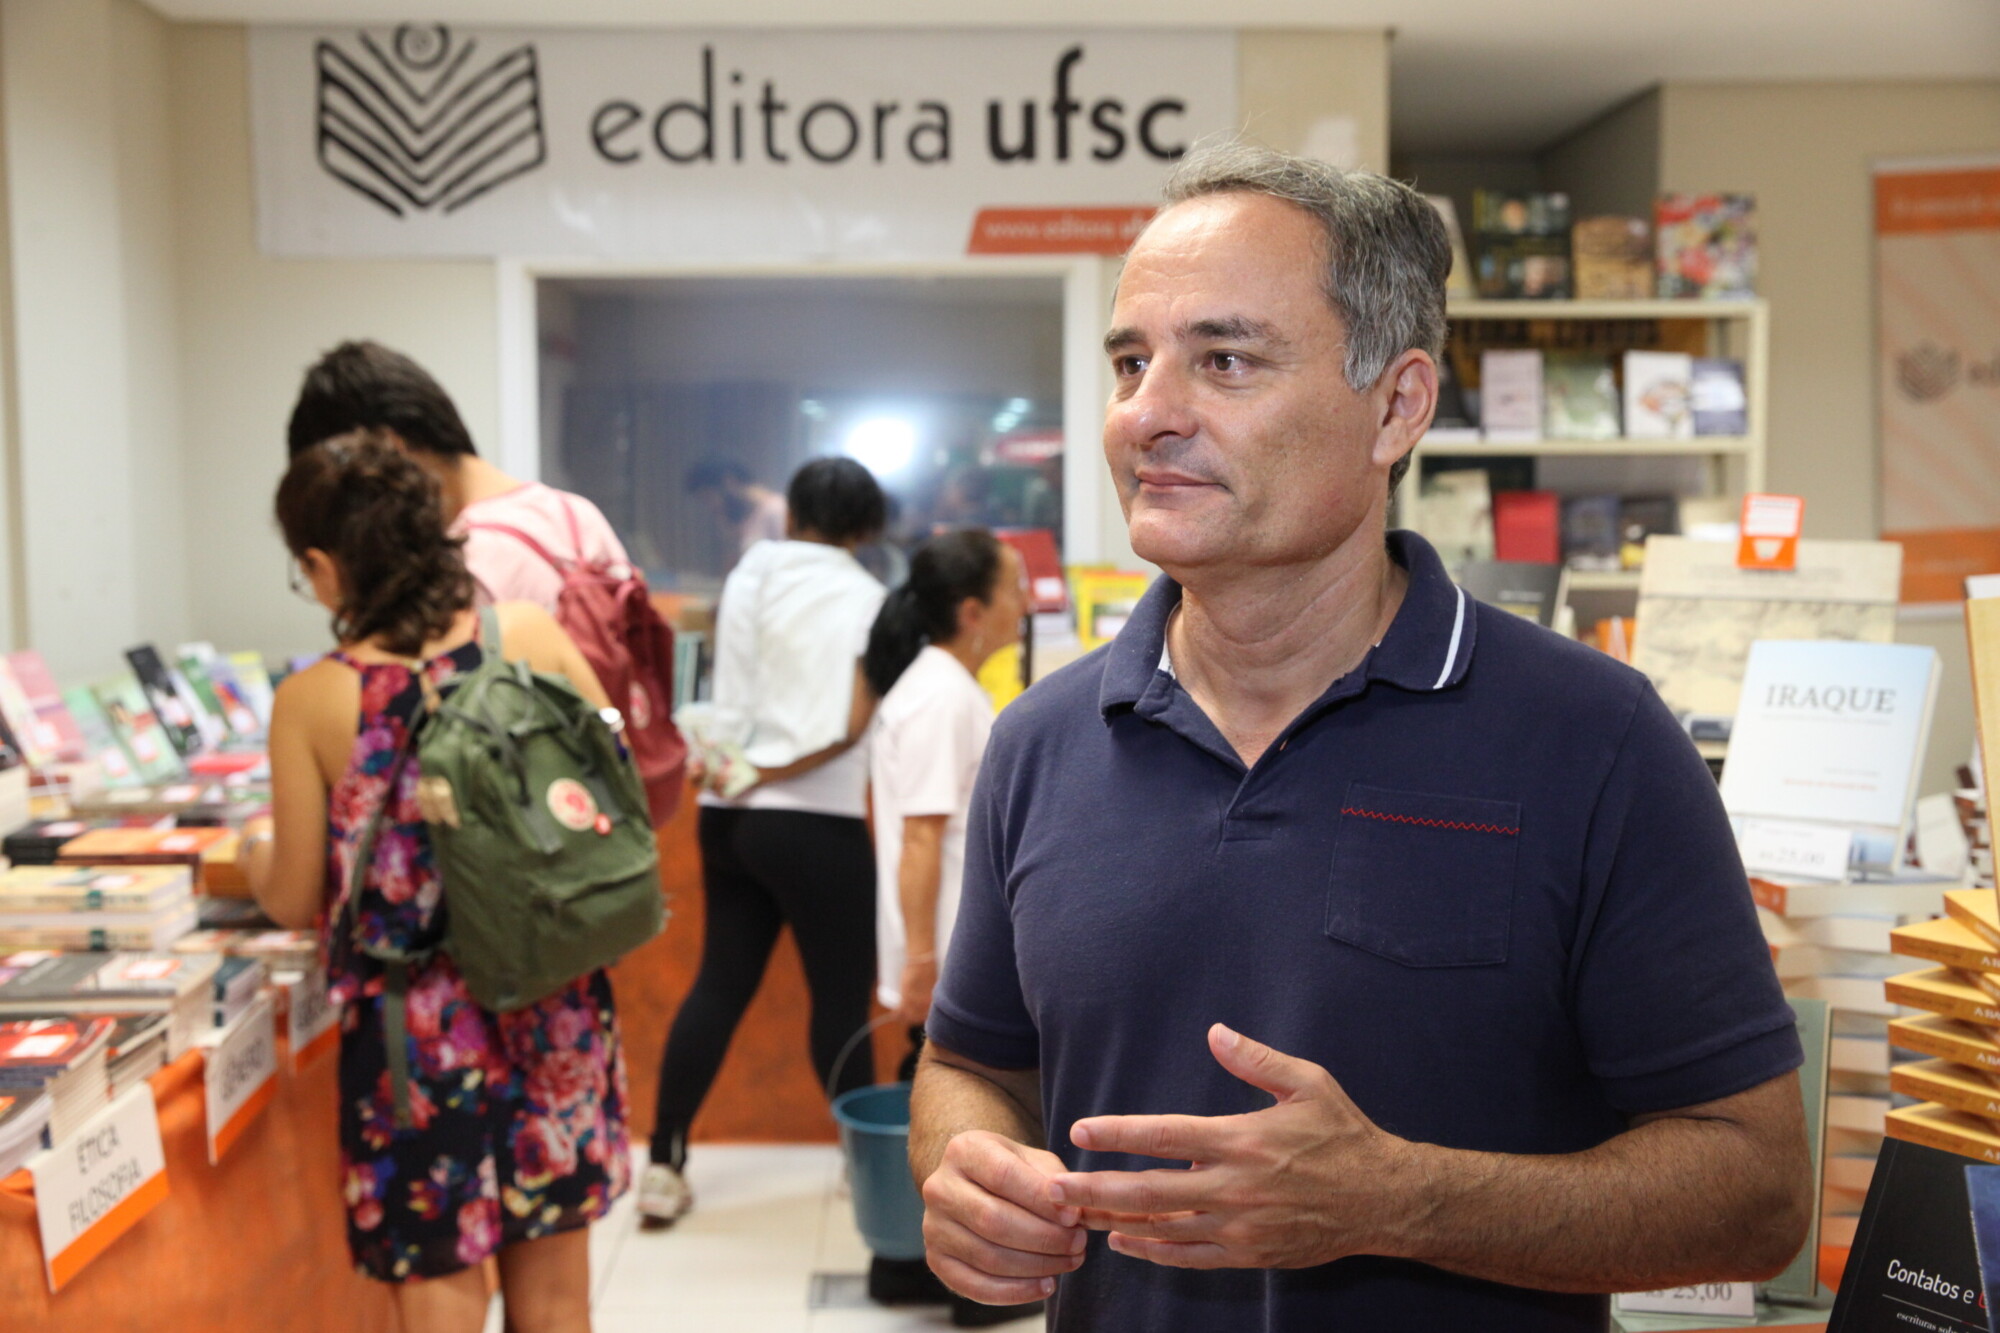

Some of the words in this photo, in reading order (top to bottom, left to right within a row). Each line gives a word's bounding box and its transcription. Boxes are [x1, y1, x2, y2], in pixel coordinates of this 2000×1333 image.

[590, 44, 952, 165] editora
[985, 43, 1188, 165] ufsc
[1766, 684, 1897, 714] IRAQUE
[68, 1155, 142, 1233] FILOSOFIA
[1886, 1259, 1961, 1300] Contatos
[1962, 1288, 1975, 1305] e
[1896, 1311, 1937, 1332] escrituras
